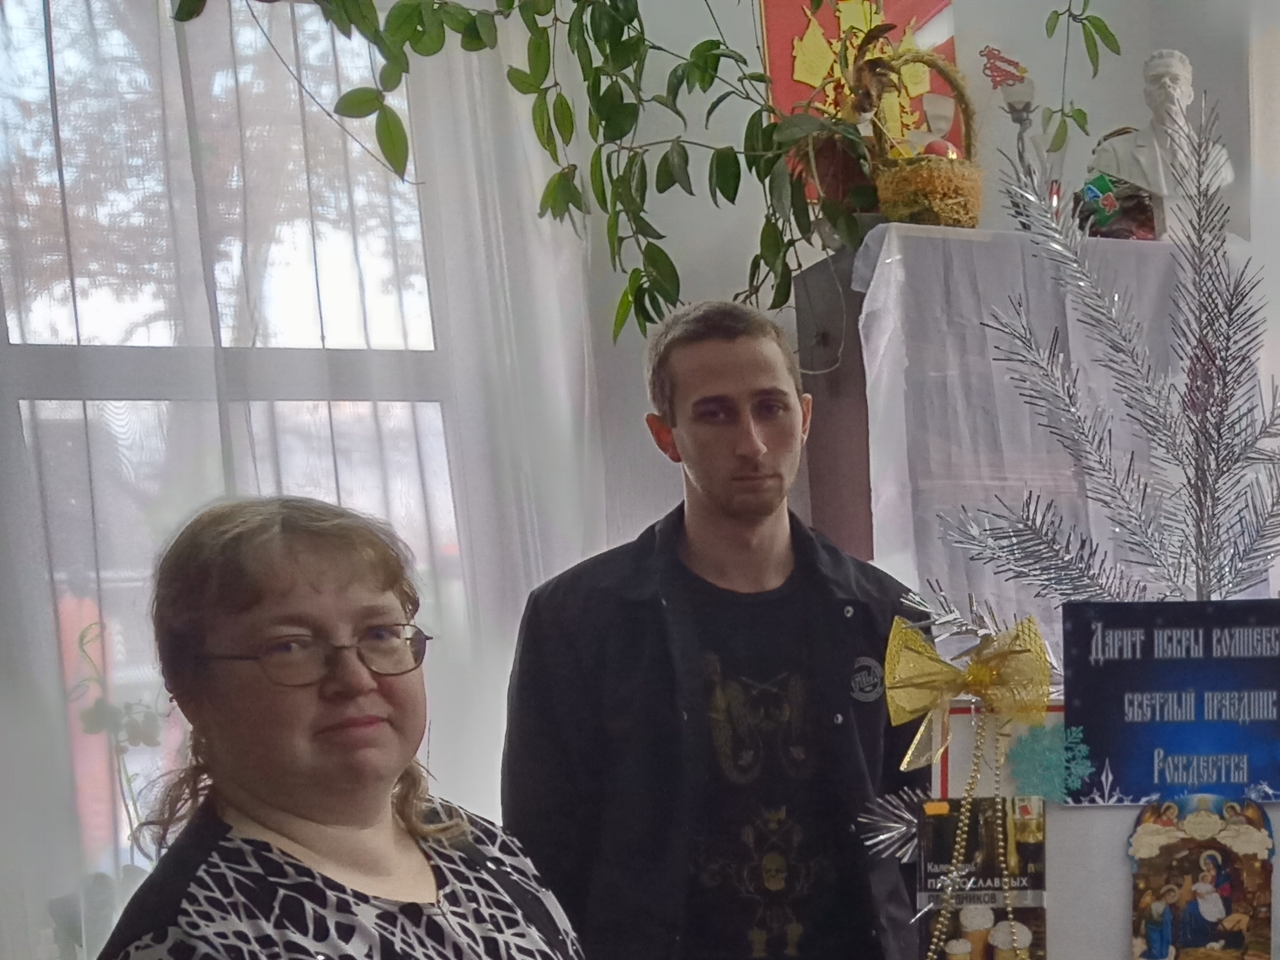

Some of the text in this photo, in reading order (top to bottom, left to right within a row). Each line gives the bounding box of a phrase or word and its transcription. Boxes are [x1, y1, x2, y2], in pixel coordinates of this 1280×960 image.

[851, 668, 881, 690] FILA
[928, 878, 1028, 889] ПРОСЛАВЫХ
[928, 893, 996, 905] ПРДНИКОВ
